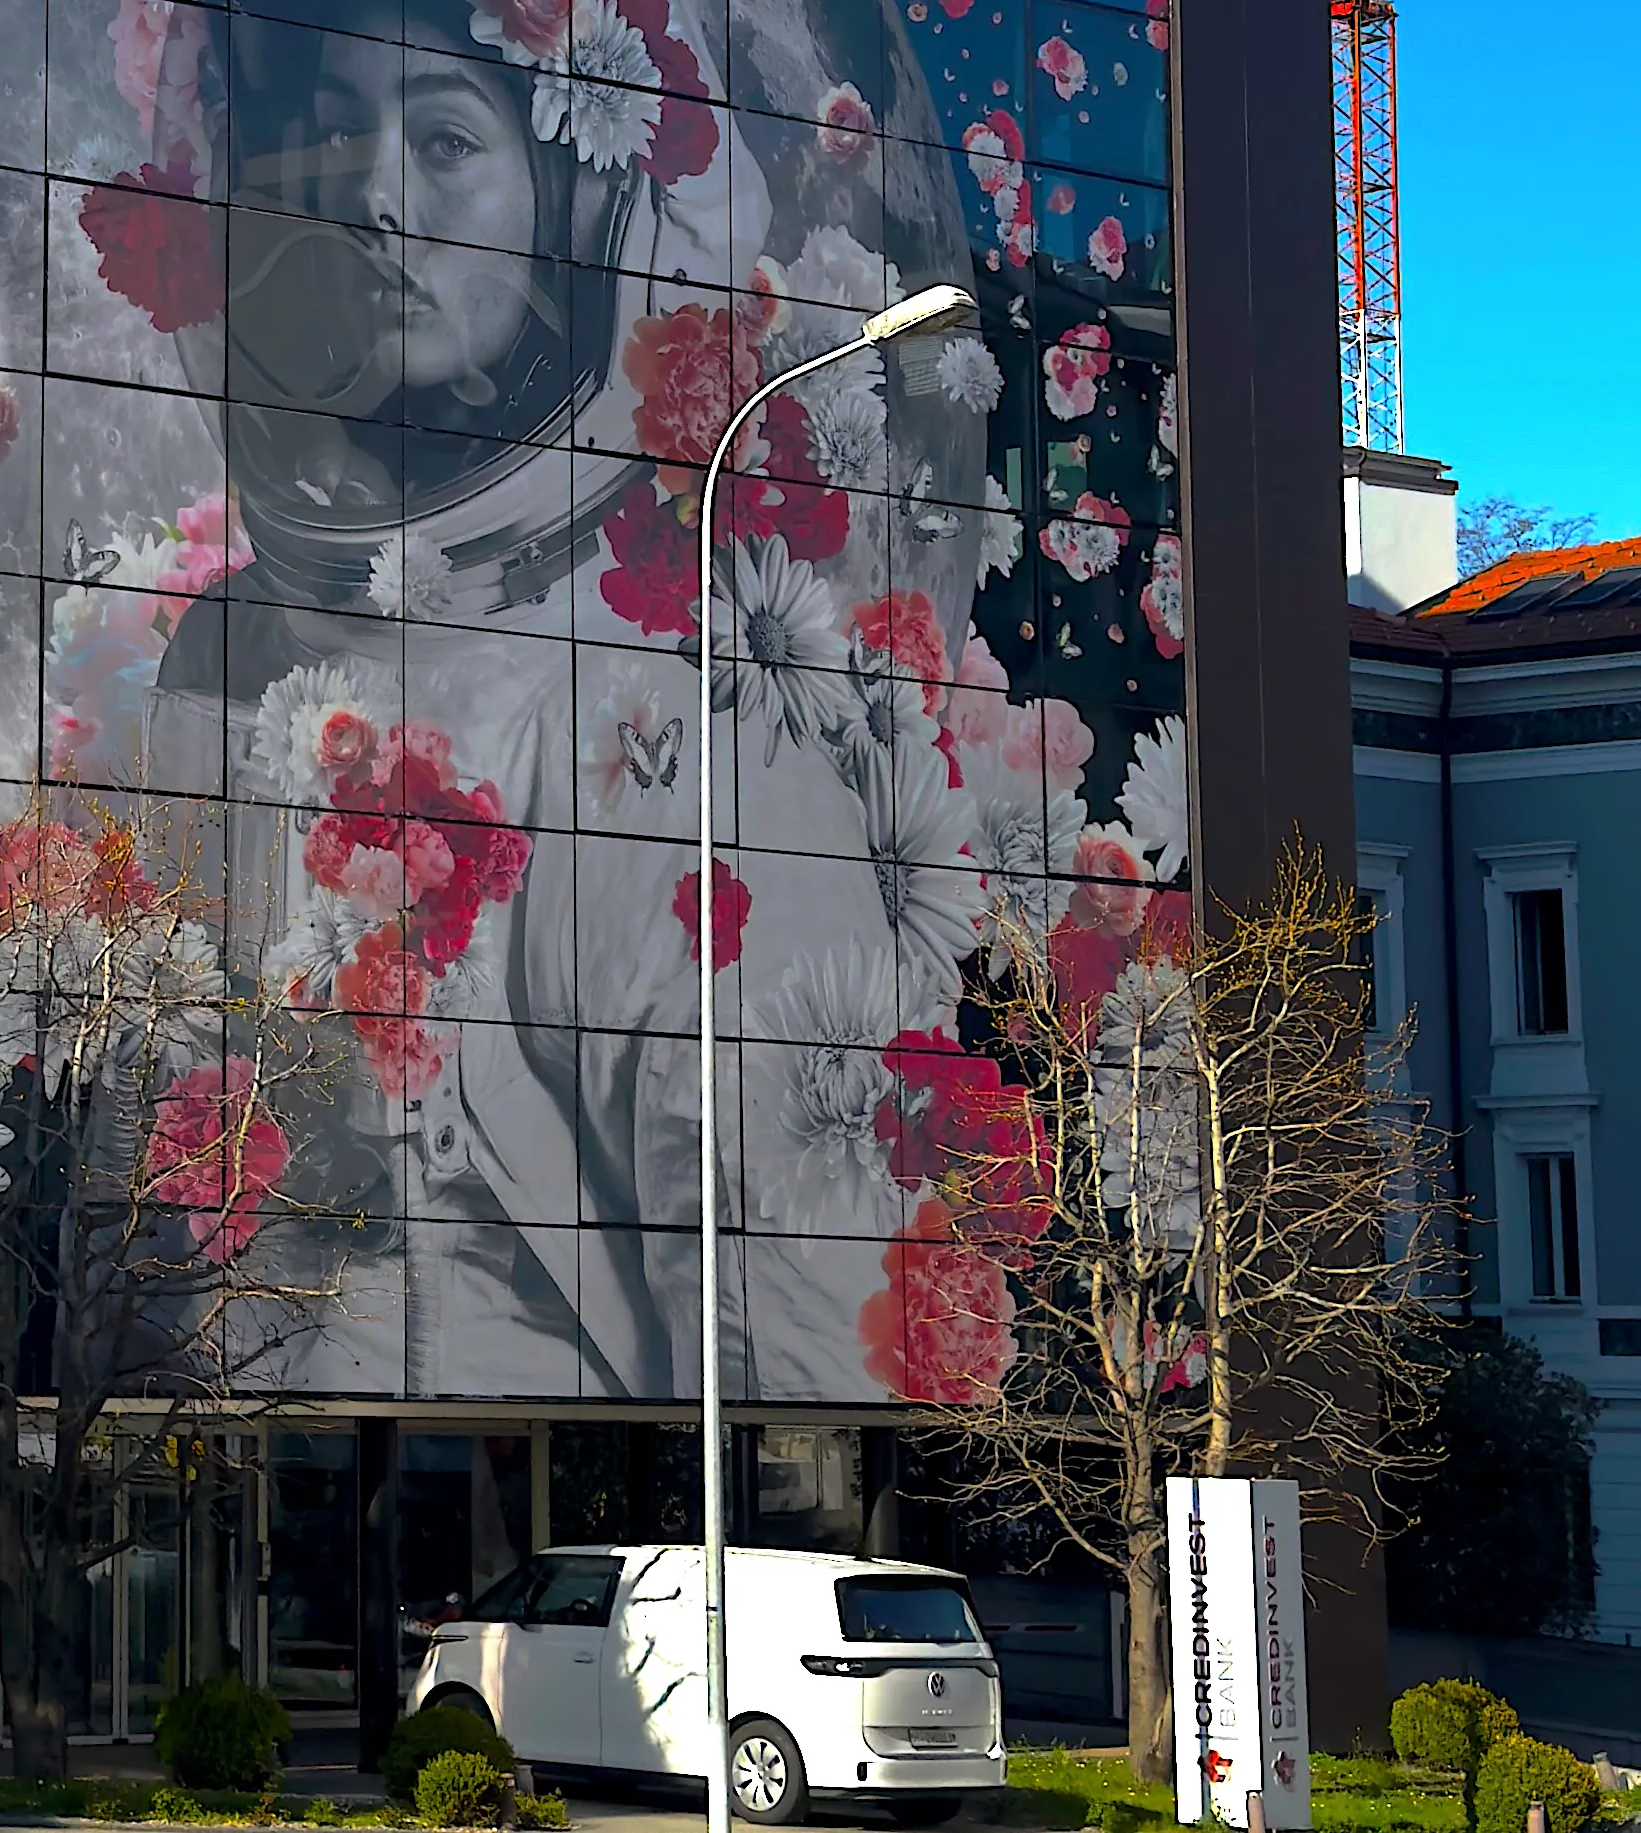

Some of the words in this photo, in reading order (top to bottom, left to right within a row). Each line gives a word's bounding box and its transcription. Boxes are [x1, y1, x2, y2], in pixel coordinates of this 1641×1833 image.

[1189, 1513, 1213, 1727] CREDINVEST
[1216, 1638, 1237, 1728] BANK
[1262, 1515, 1283, 1729] CREDINVEST
[1283, 1638, 1297, 1728] BANK
